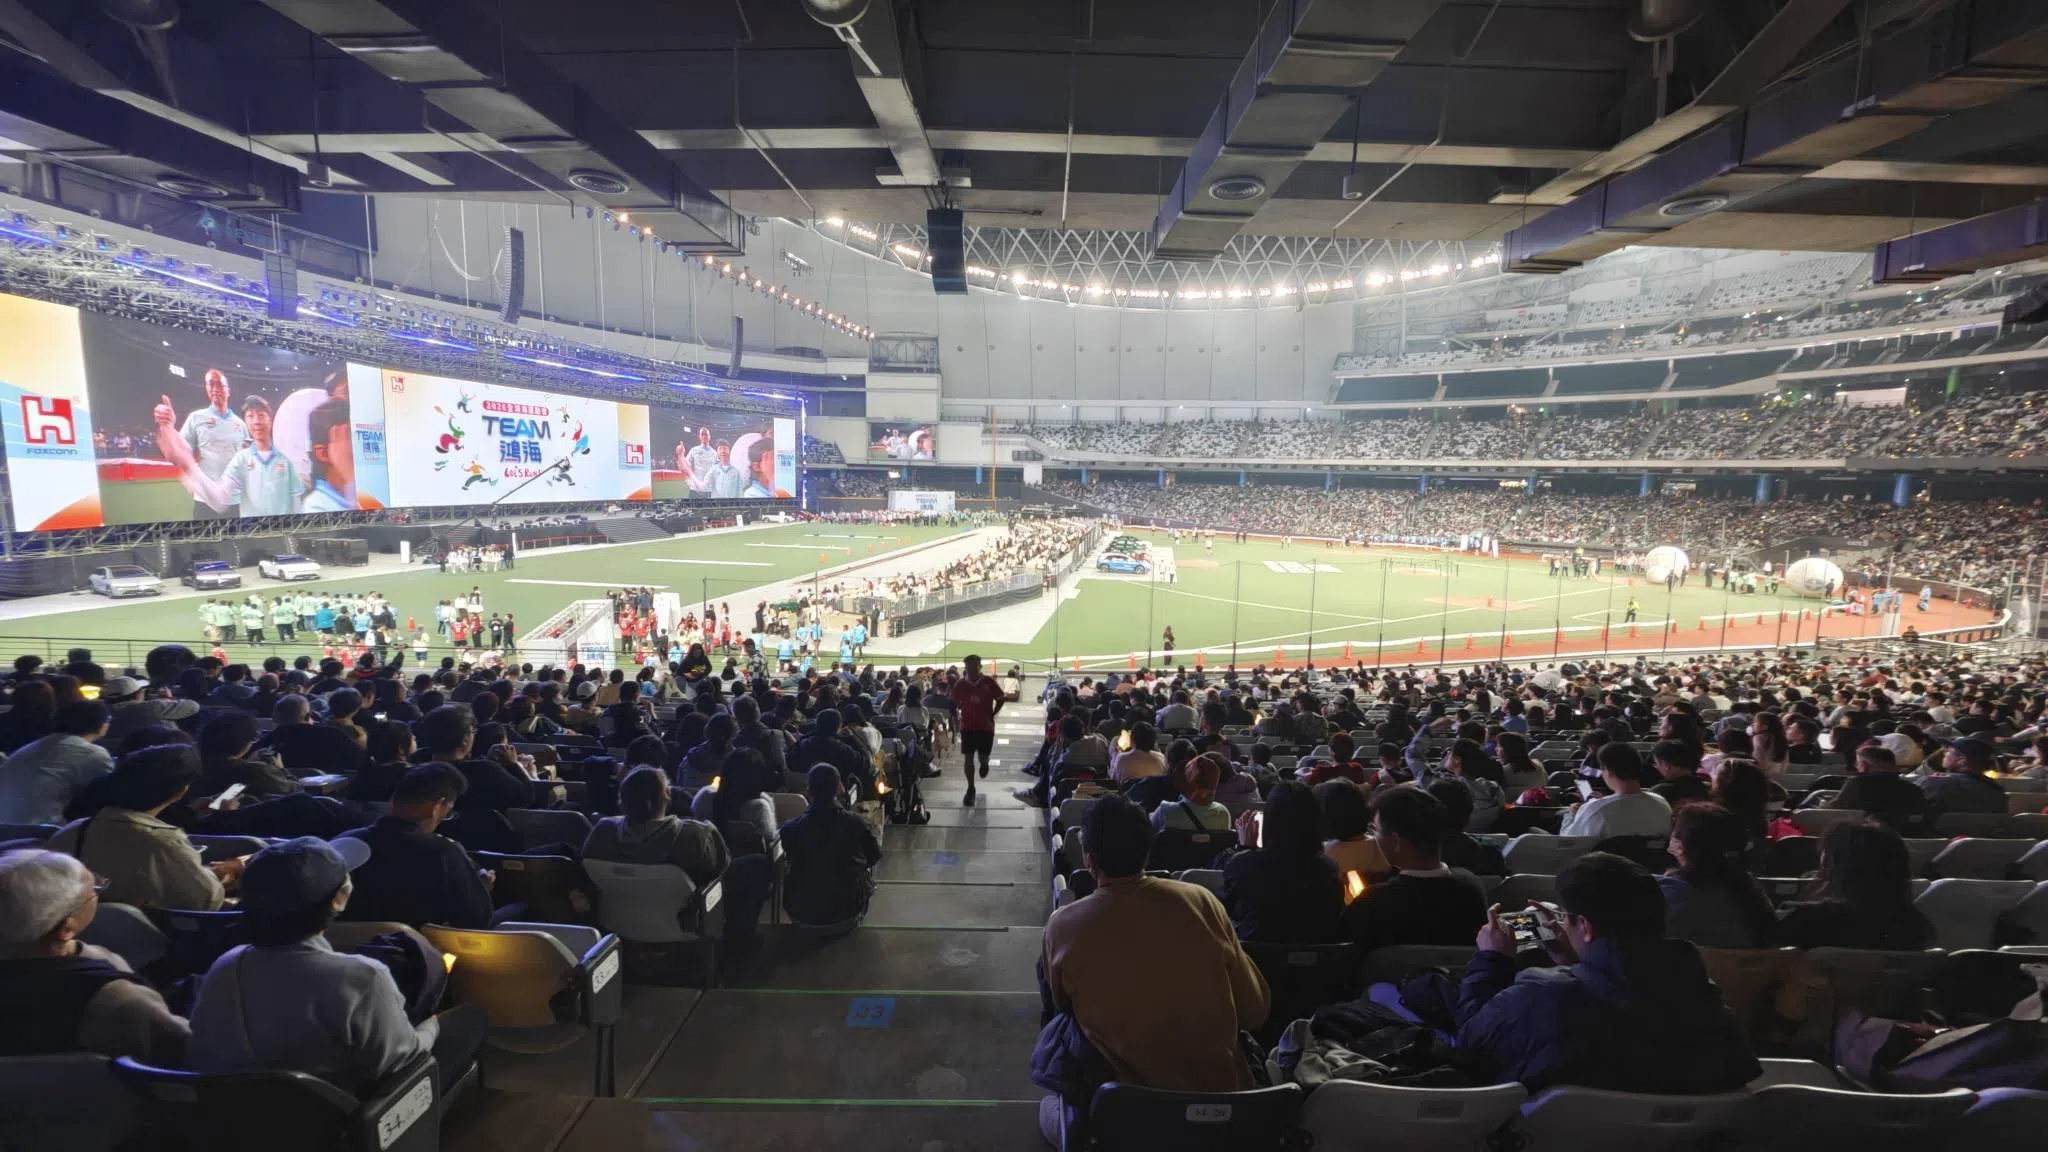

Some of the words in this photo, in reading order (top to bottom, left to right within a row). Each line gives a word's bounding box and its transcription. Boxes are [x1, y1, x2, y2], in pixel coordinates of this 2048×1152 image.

[356, 430, 384, 441] TEAM
[482, 415, 551, 439] TEAM
[500, 440, 542, 462] 鴻海
